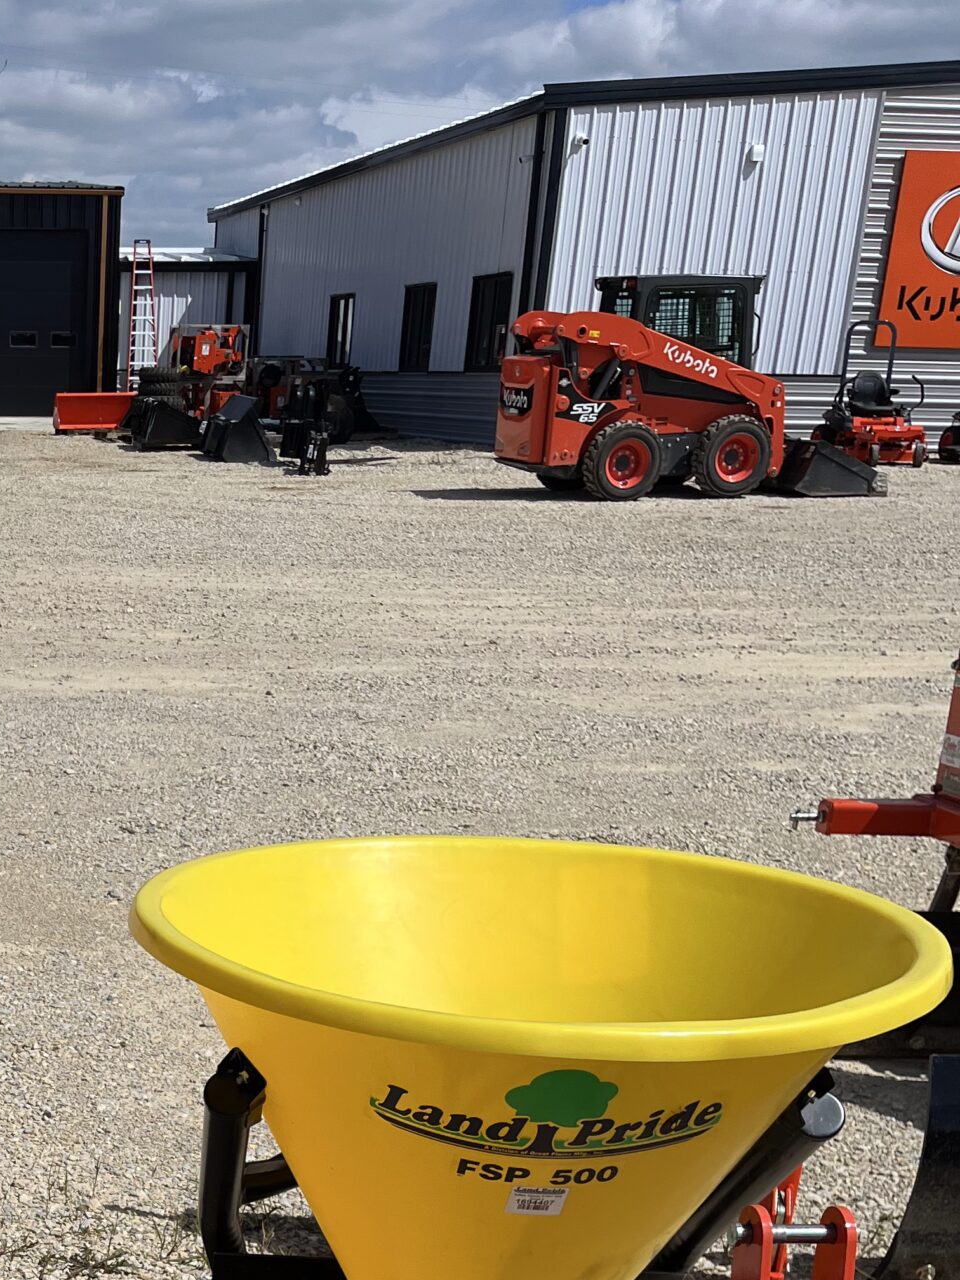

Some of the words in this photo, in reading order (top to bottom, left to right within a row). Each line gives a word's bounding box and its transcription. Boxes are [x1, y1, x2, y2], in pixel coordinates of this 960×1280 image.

[663, 342, 718, 378] Kubota
[503, 389, 528, 409] Kubota
[570, 402, 606, 415] SSV
[578, 413, 598, 423] 65
[378, 1084, 529, 1143] Land
[567, 1099, 724, 1148] Pride
[456, 1158, 530, 1184] FSP
[549, 1165, 618, 1186] 500
